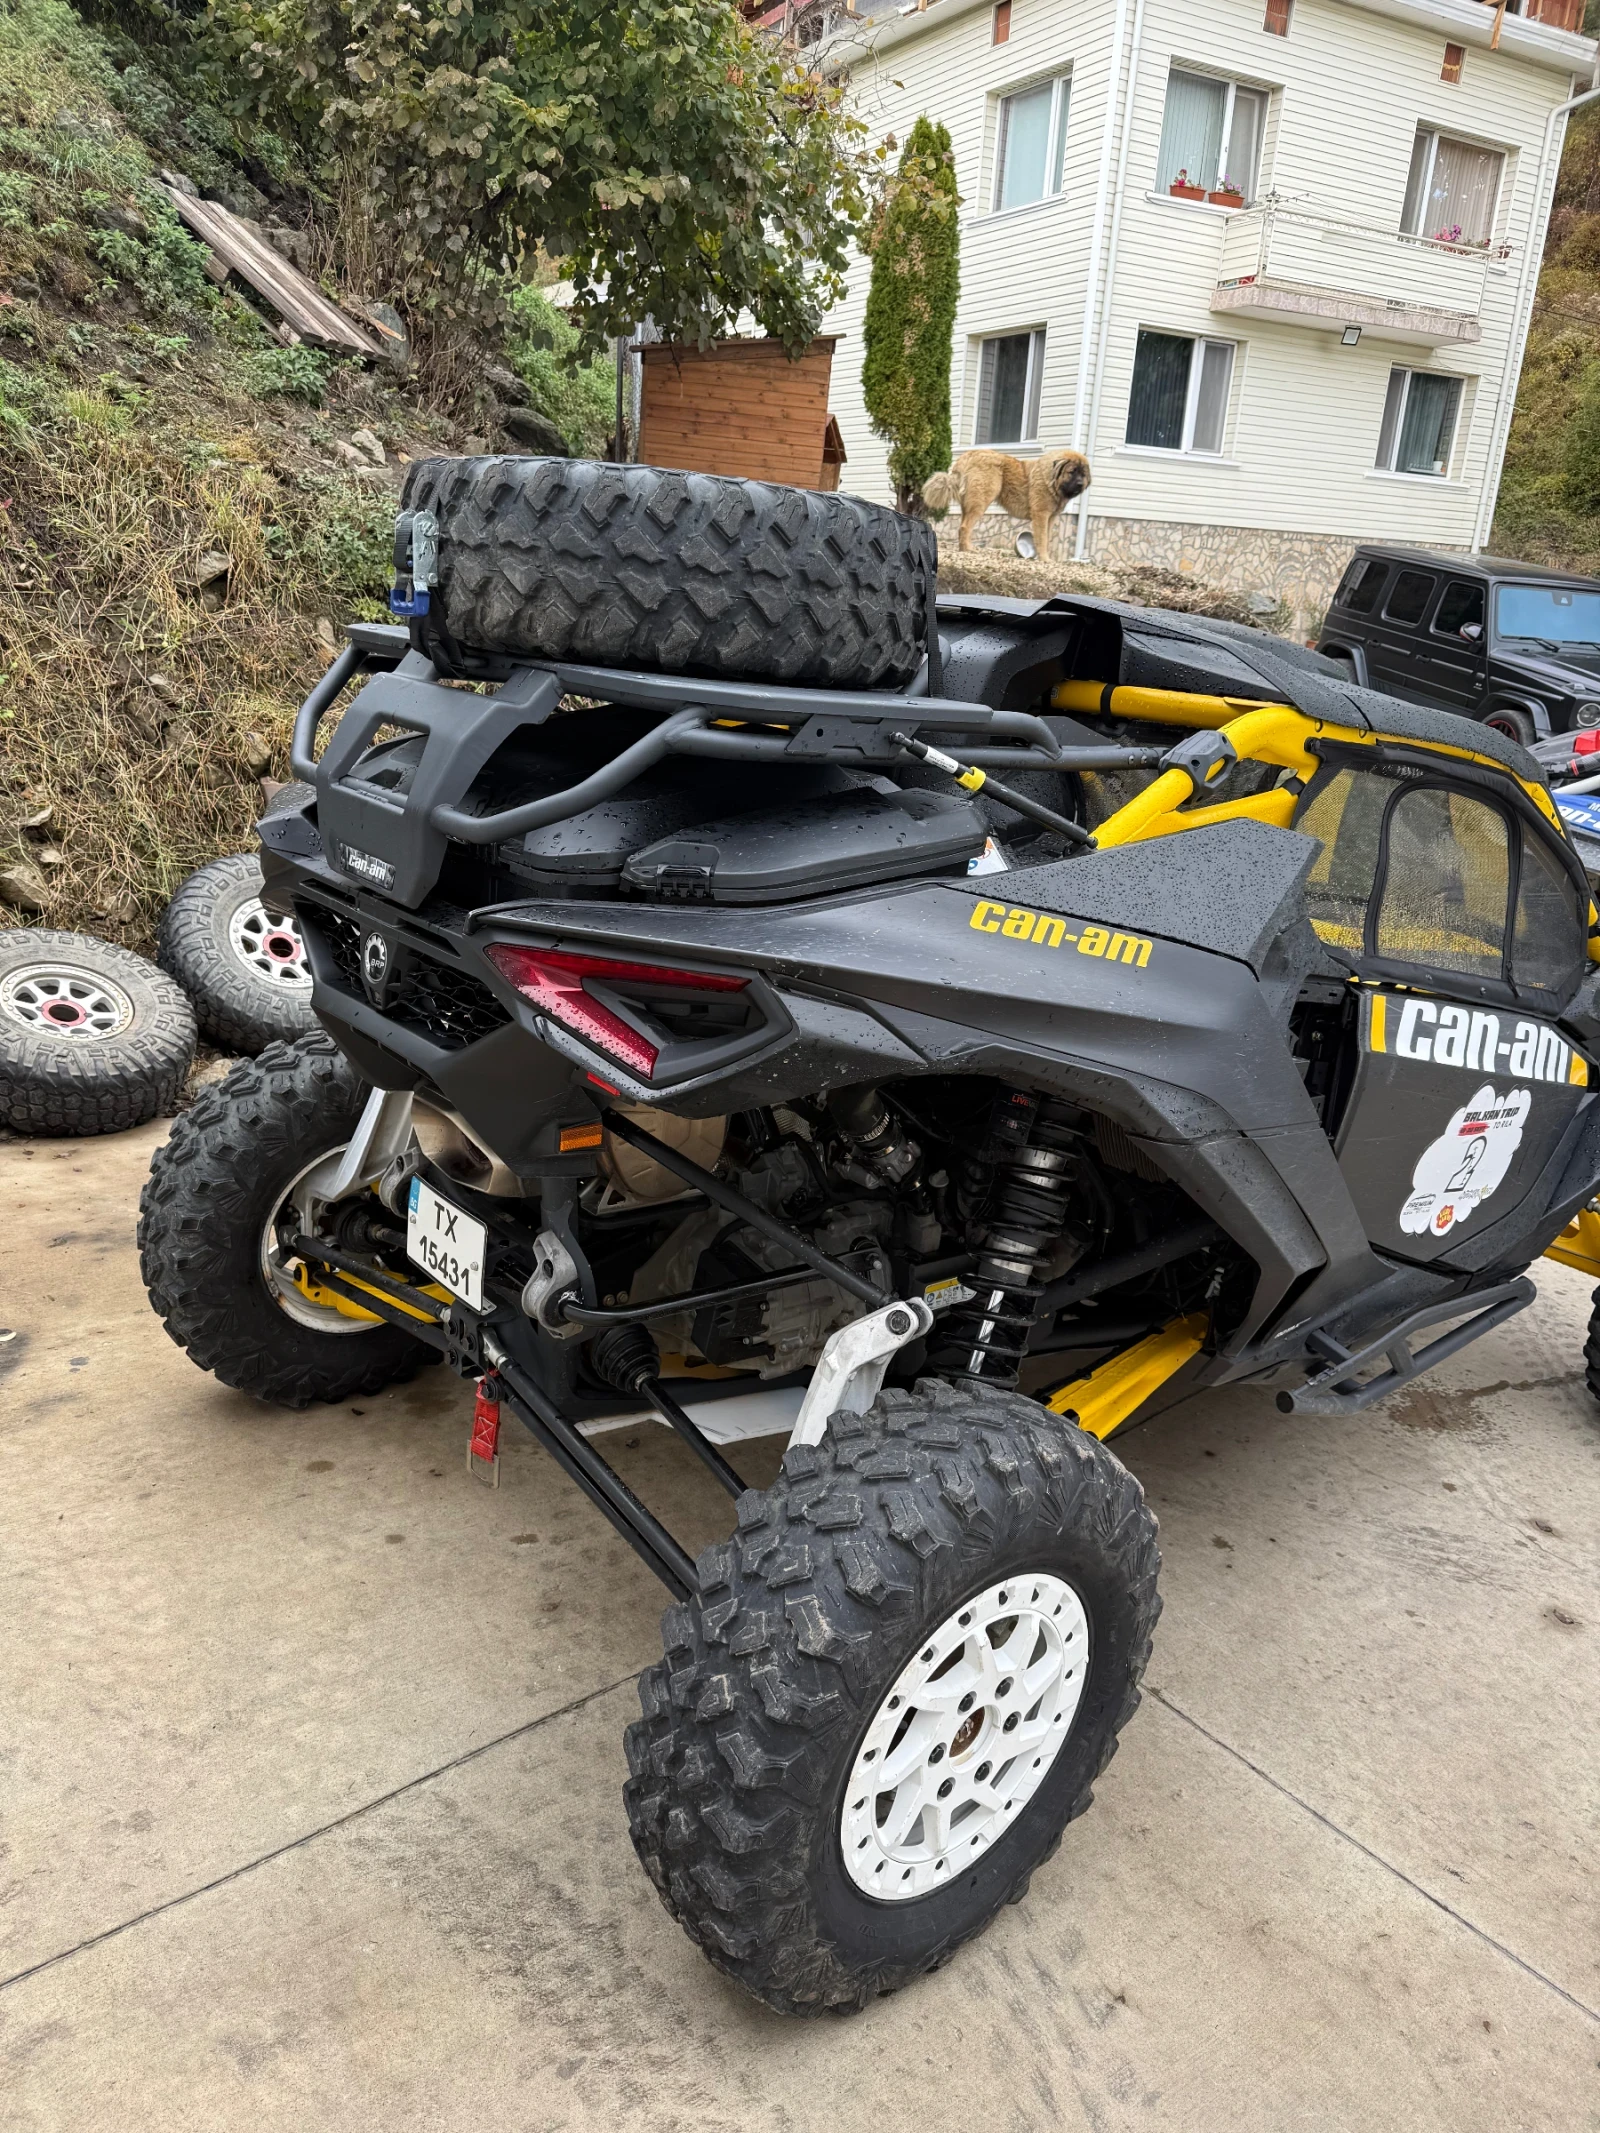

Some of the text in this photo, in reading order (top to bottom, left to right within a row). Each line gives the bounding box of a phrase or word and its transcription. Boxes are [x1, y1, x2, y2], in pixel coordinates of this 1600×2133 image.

[348, 854, 387, 881] can-am
[969, 900, 1153, 968] can-am
[371, 958, 385, 969] BRP
[1396, 999, 1568, 1083] can-am
[1463, 1106, 1520, 1123] BALKAN TRIP
[434, 1200, 458, 1243] TX
[419, 1234, 470, 1296] 15431
